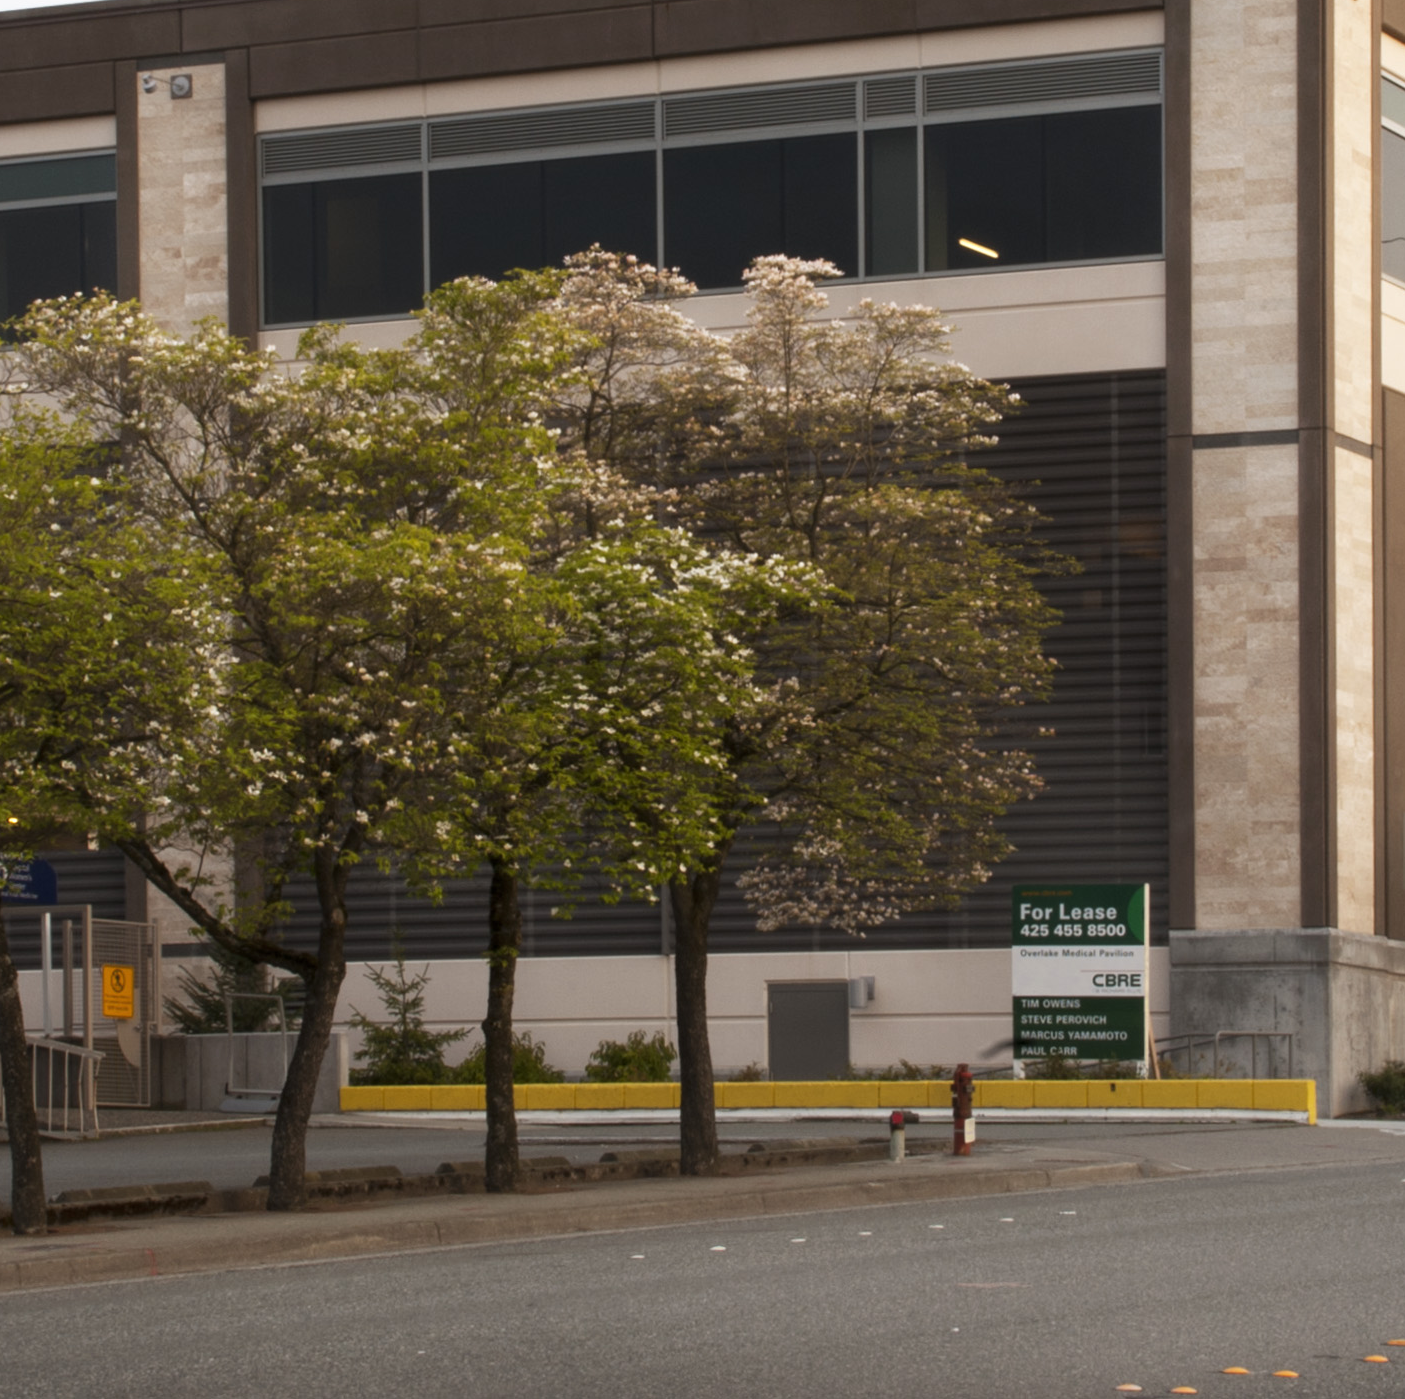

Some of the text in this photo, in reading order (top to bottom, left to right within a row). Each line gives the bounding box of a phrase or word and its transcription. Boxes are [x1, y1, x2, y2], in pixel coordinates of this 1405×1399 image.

[1020, 903, 1118, 920] For Lease
[1020, 924, 1126, 937] 425 455 8500
[1020, 949, 1134, 957] Overlake Medical Pavilion
[1092, 973, 1141, 987] CBRE
[1021, 999, 1081, 1009] TIM OWENS
[1021, 1014, 1107, 1024] STEVE PEROVICH
[1021, 1030, 1128, 1041] MARCUS YAMAMOTO
[1021, 1046, 1078, 1056] PAUL CARR
